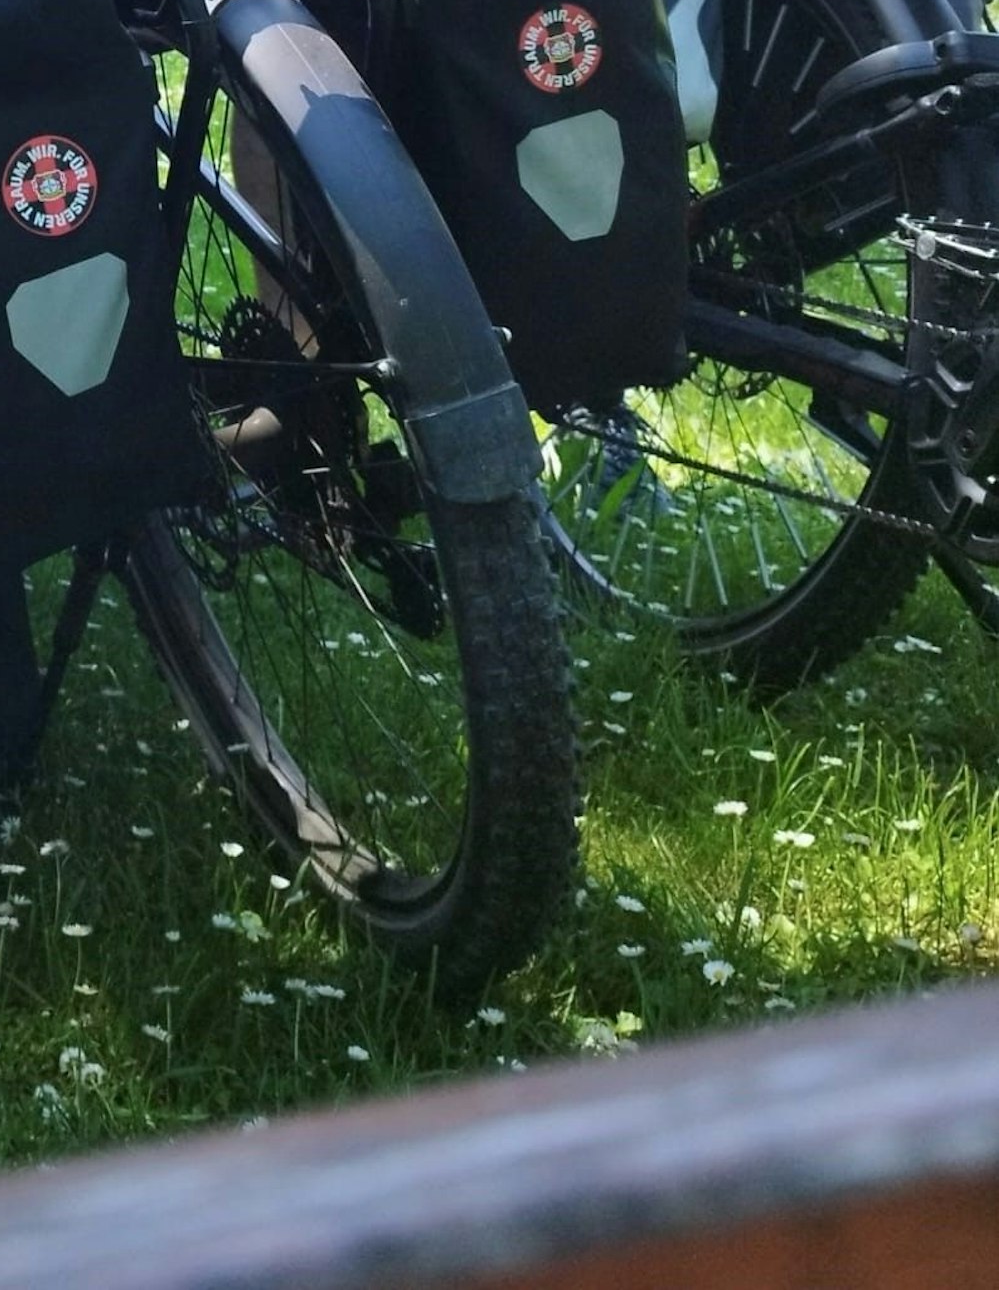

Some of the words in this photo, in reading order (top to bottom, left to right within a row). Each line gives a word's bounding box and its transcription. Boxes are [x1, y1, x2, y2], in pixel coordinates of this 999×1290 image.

[539, 9, 571, 27] WIR.
[544, 45, 597, 88] UNSEREN
[27, 144, 61, 163] WIR.
[10, 161, 33, 221] TRAUM.
[33, 183, 90, 229] UNSEREN
